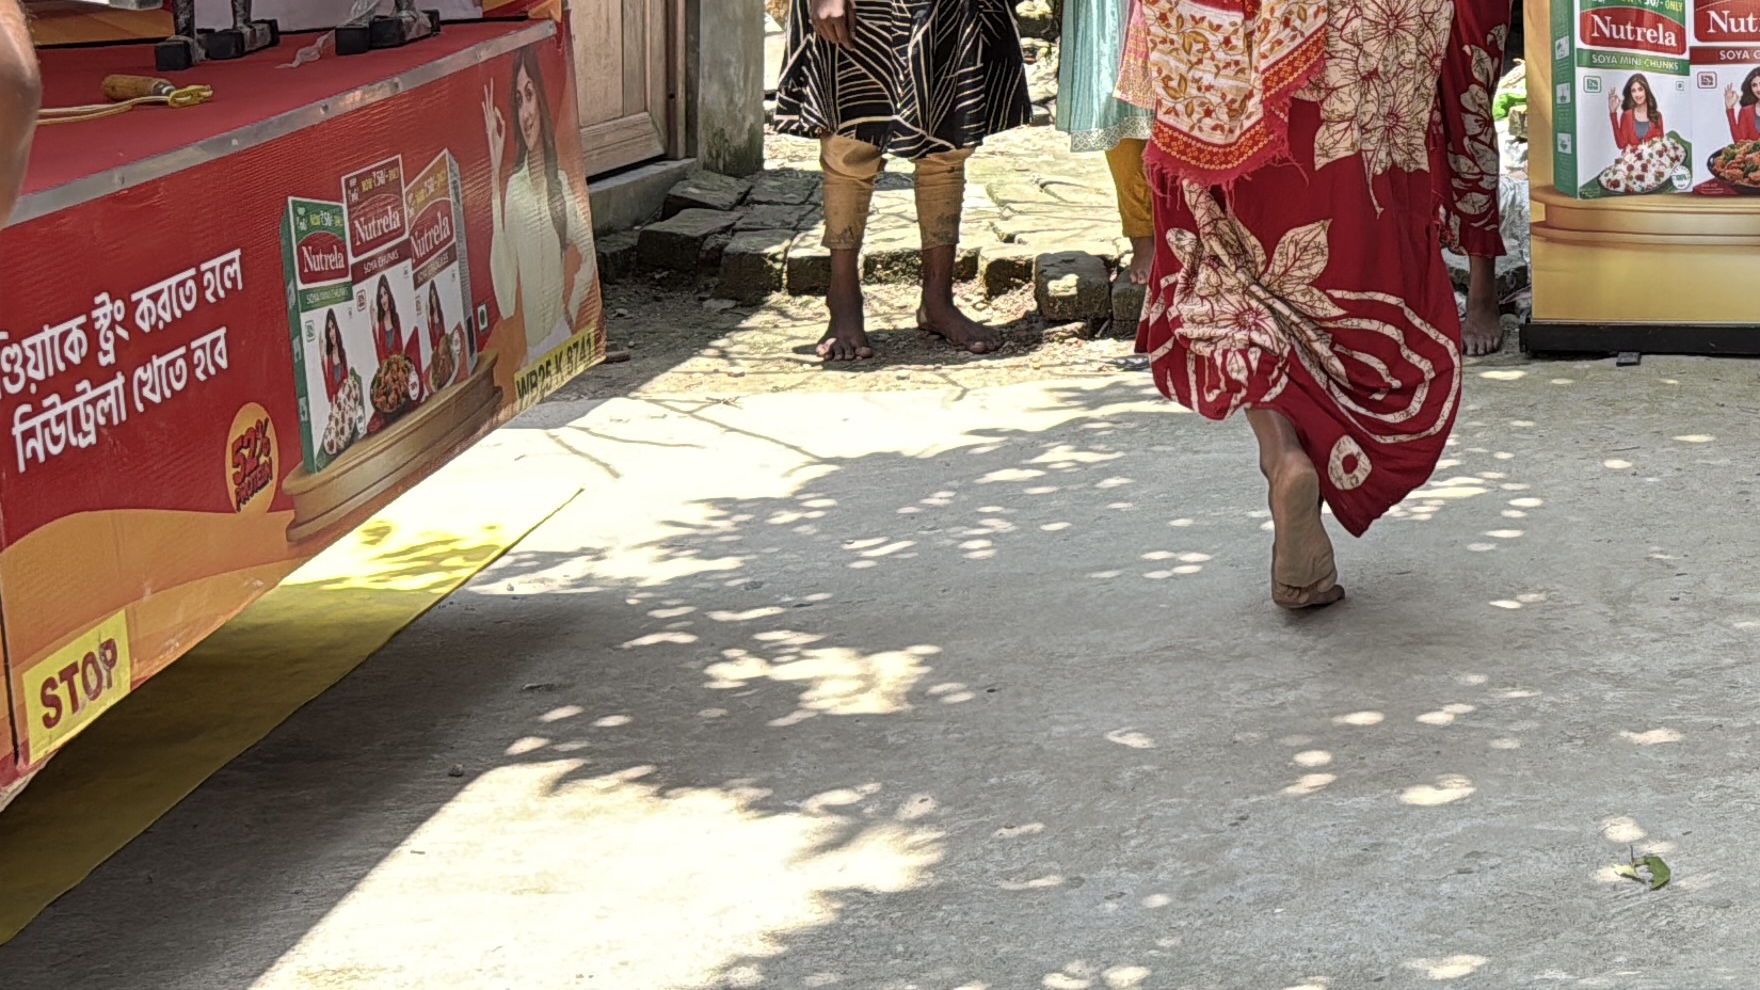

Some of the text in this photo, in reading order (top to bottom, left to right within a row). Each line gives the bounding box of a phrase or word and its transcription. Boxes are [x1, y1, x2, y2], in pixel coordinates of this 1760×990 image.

[1591, 13, 1678, 48] Nutrela
[1591, 53, 1618, 65] SOYA
[1643, 58, 1680, 71] CHUNKS
[1719, 50, 1750, 61] SOYA
[354, 204, 401, 246] Nutrela
[410, 210, 451, 263] Nutrela
[301, 244, 345, 273] Nutrela
[131, 267, 197, 334] করতে
[200, 248, 243, 304] হলে
[12, 326, 229, 474] নিউট্রেলা খেতে হবে
[231, 417, 270, 487] 52%
[40, 637, 118, 730] STOP
